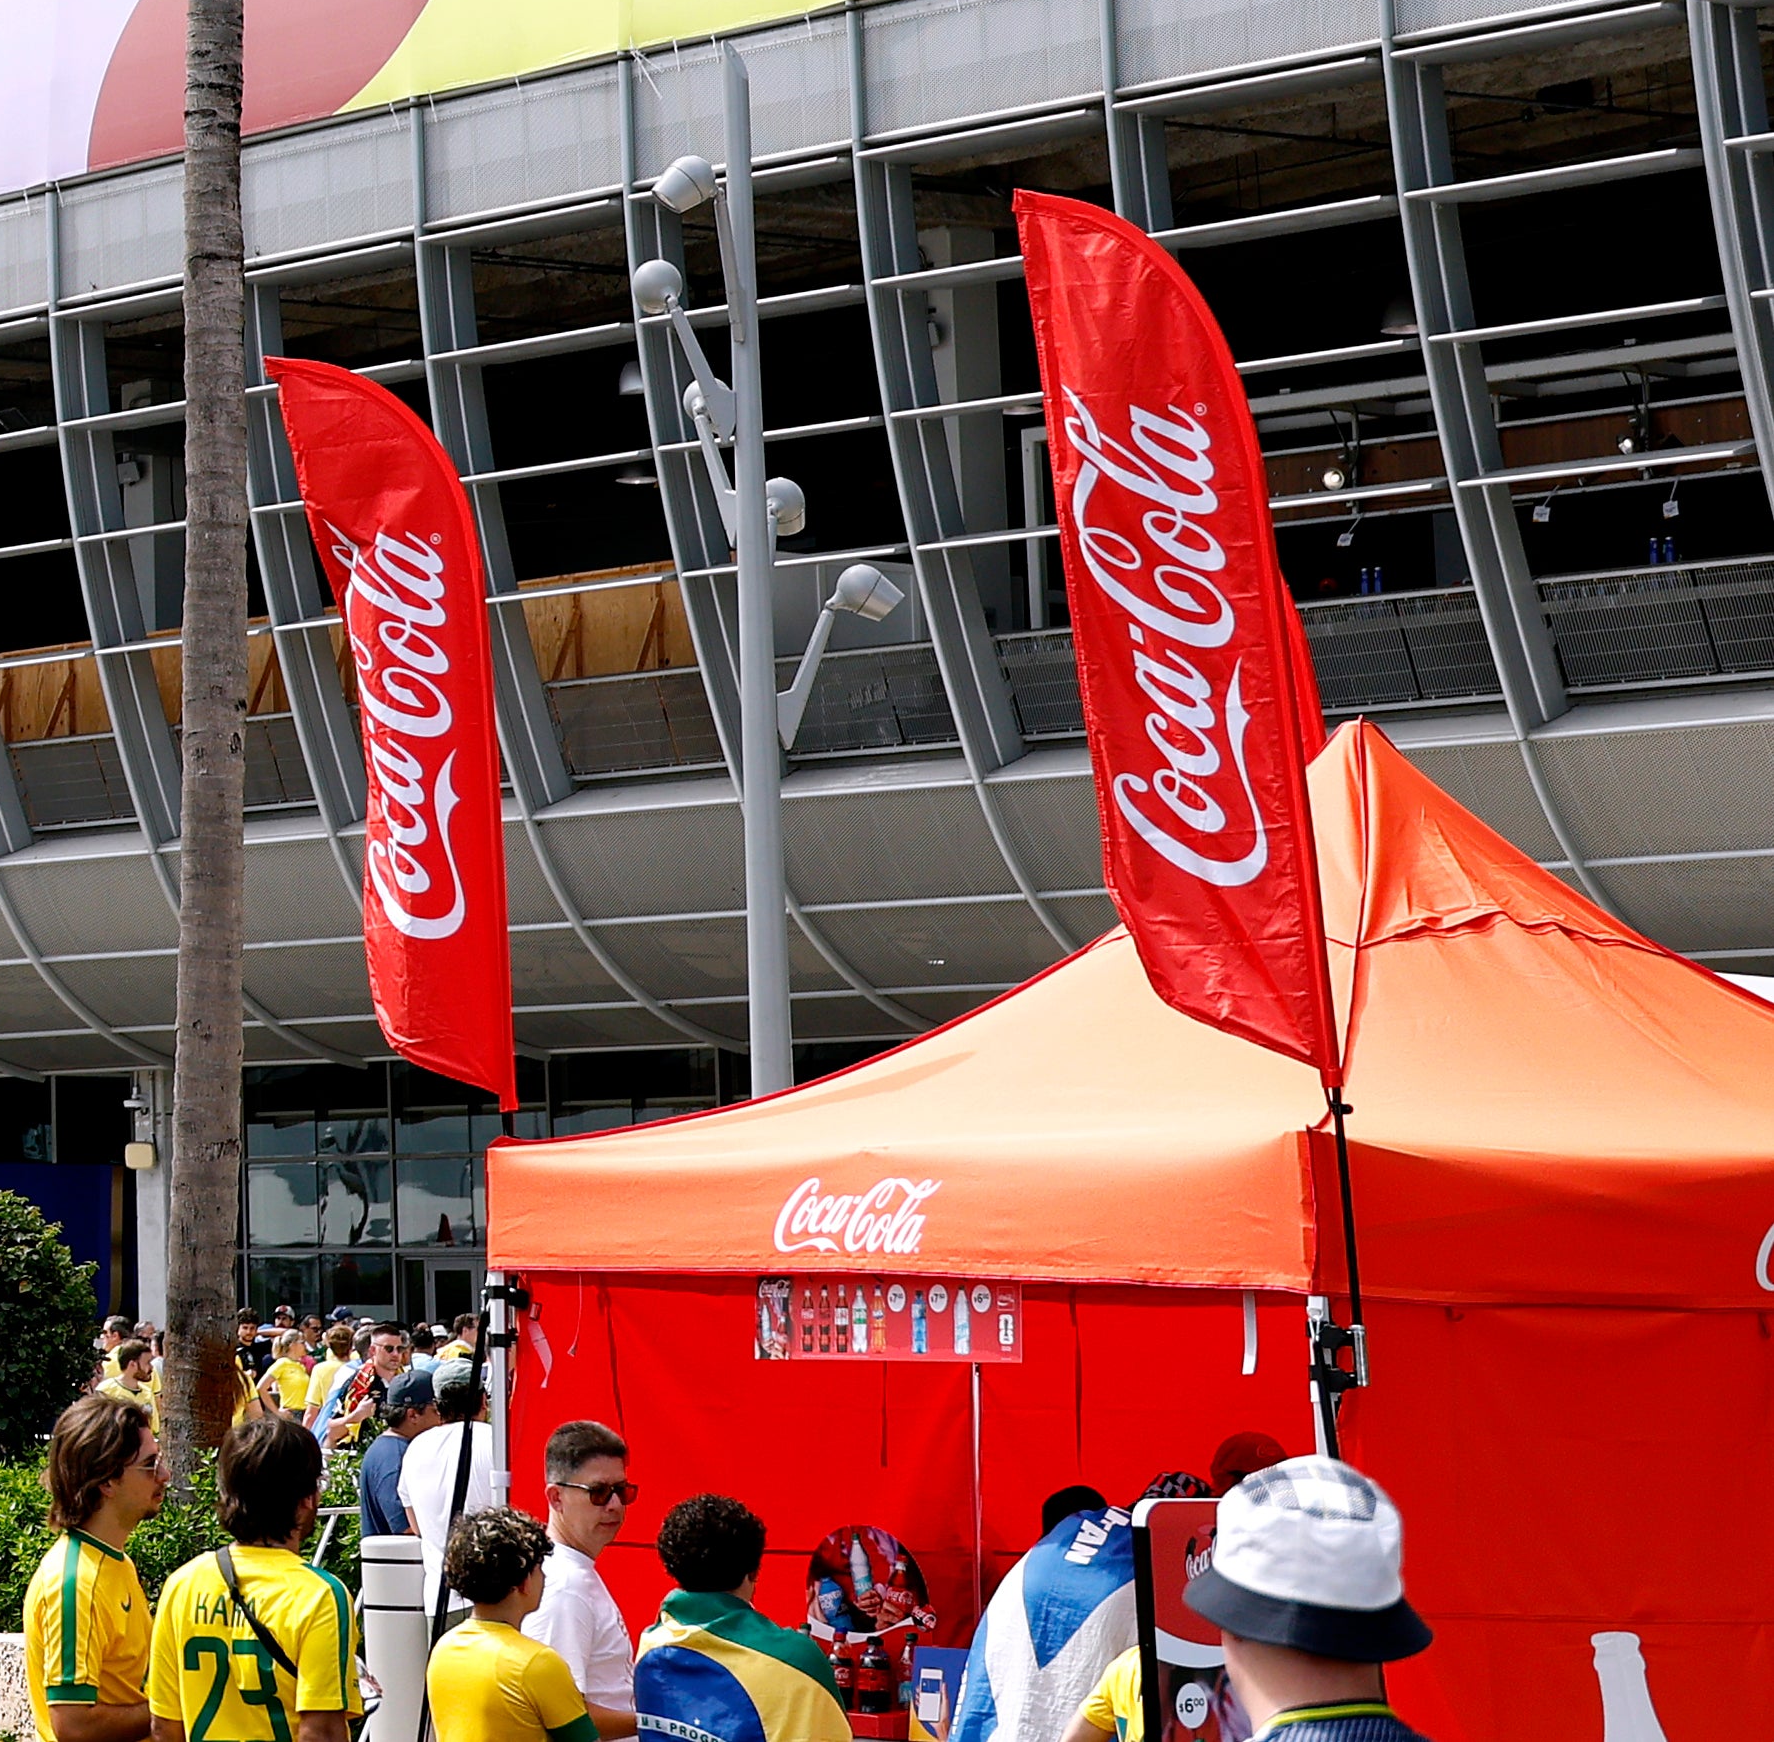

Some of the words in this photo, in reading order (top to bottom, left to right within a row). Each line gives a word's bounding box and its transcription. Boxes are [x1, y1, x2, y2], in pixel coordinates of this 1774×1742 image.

[323, 519, 466, 940] Coca-Cola
[1062, 384, 1268, 887] Coca-Cola
[773, 1177, 943, 1254] Coca-Cola
[183, 1636, 293, 1742] 23
